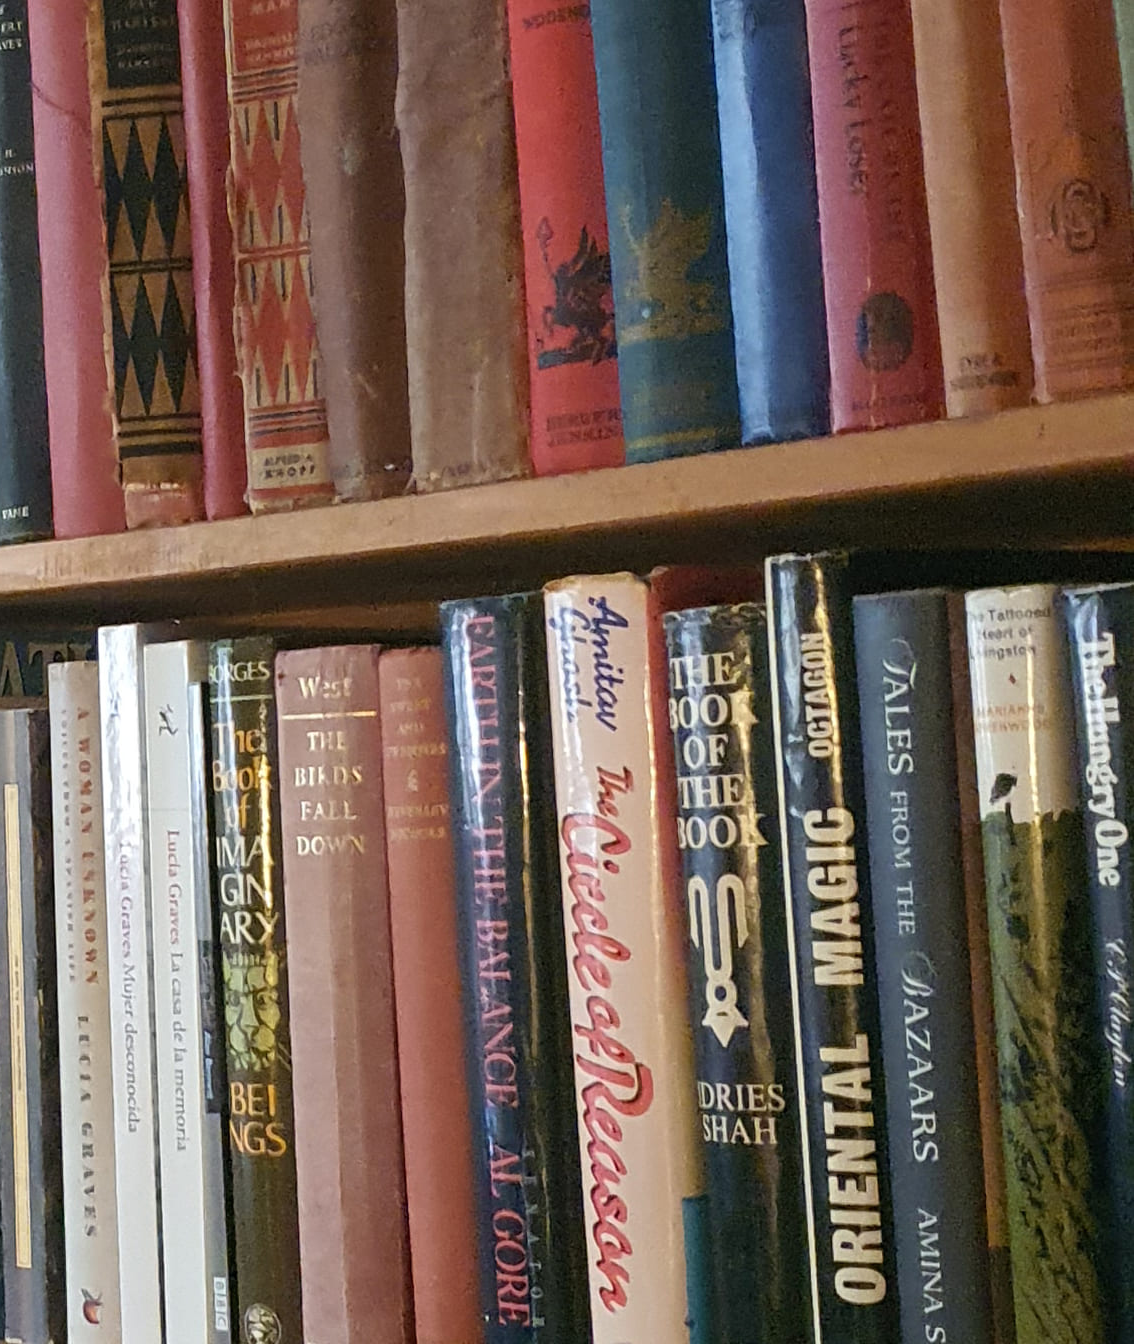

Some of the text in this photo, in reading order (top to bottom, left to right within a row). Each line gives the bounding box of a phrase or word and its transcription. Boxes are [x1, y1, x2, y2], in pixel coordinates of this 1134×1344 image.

[587, 594, 629, 733] Amitav
[669, 652, 740, 690] THE
[298, 675, 352, 701] West
[799, 630, 832, 760] OCTAGON
[667, 690, 759, 733] BOOK
[306, 730, 347, 753] THE
[682, 732, 730, 772] OF
[293, 765, 363, 788] BIRDS
[596, 762, 634, 818] The
[677, 772, 746, 809] THE
[299, 799, 358, 823] FALL
[295, 834, 366, 858] DOWN
[677, 812, 769, 850] BOOK
[560, 811, 633, 996] Circle
[878, 633, 940, 1166] TALES FROM THE BAZAARS
[218, 910, 280, 945] ARY
[803, 804, 888, 1307] ORIENTAL MAGIC
[701, 1115, 779, 1146] SHAH
[576, 1046, 656, 1315] Reason
[917, 1205, 945, 1315] AMINA
